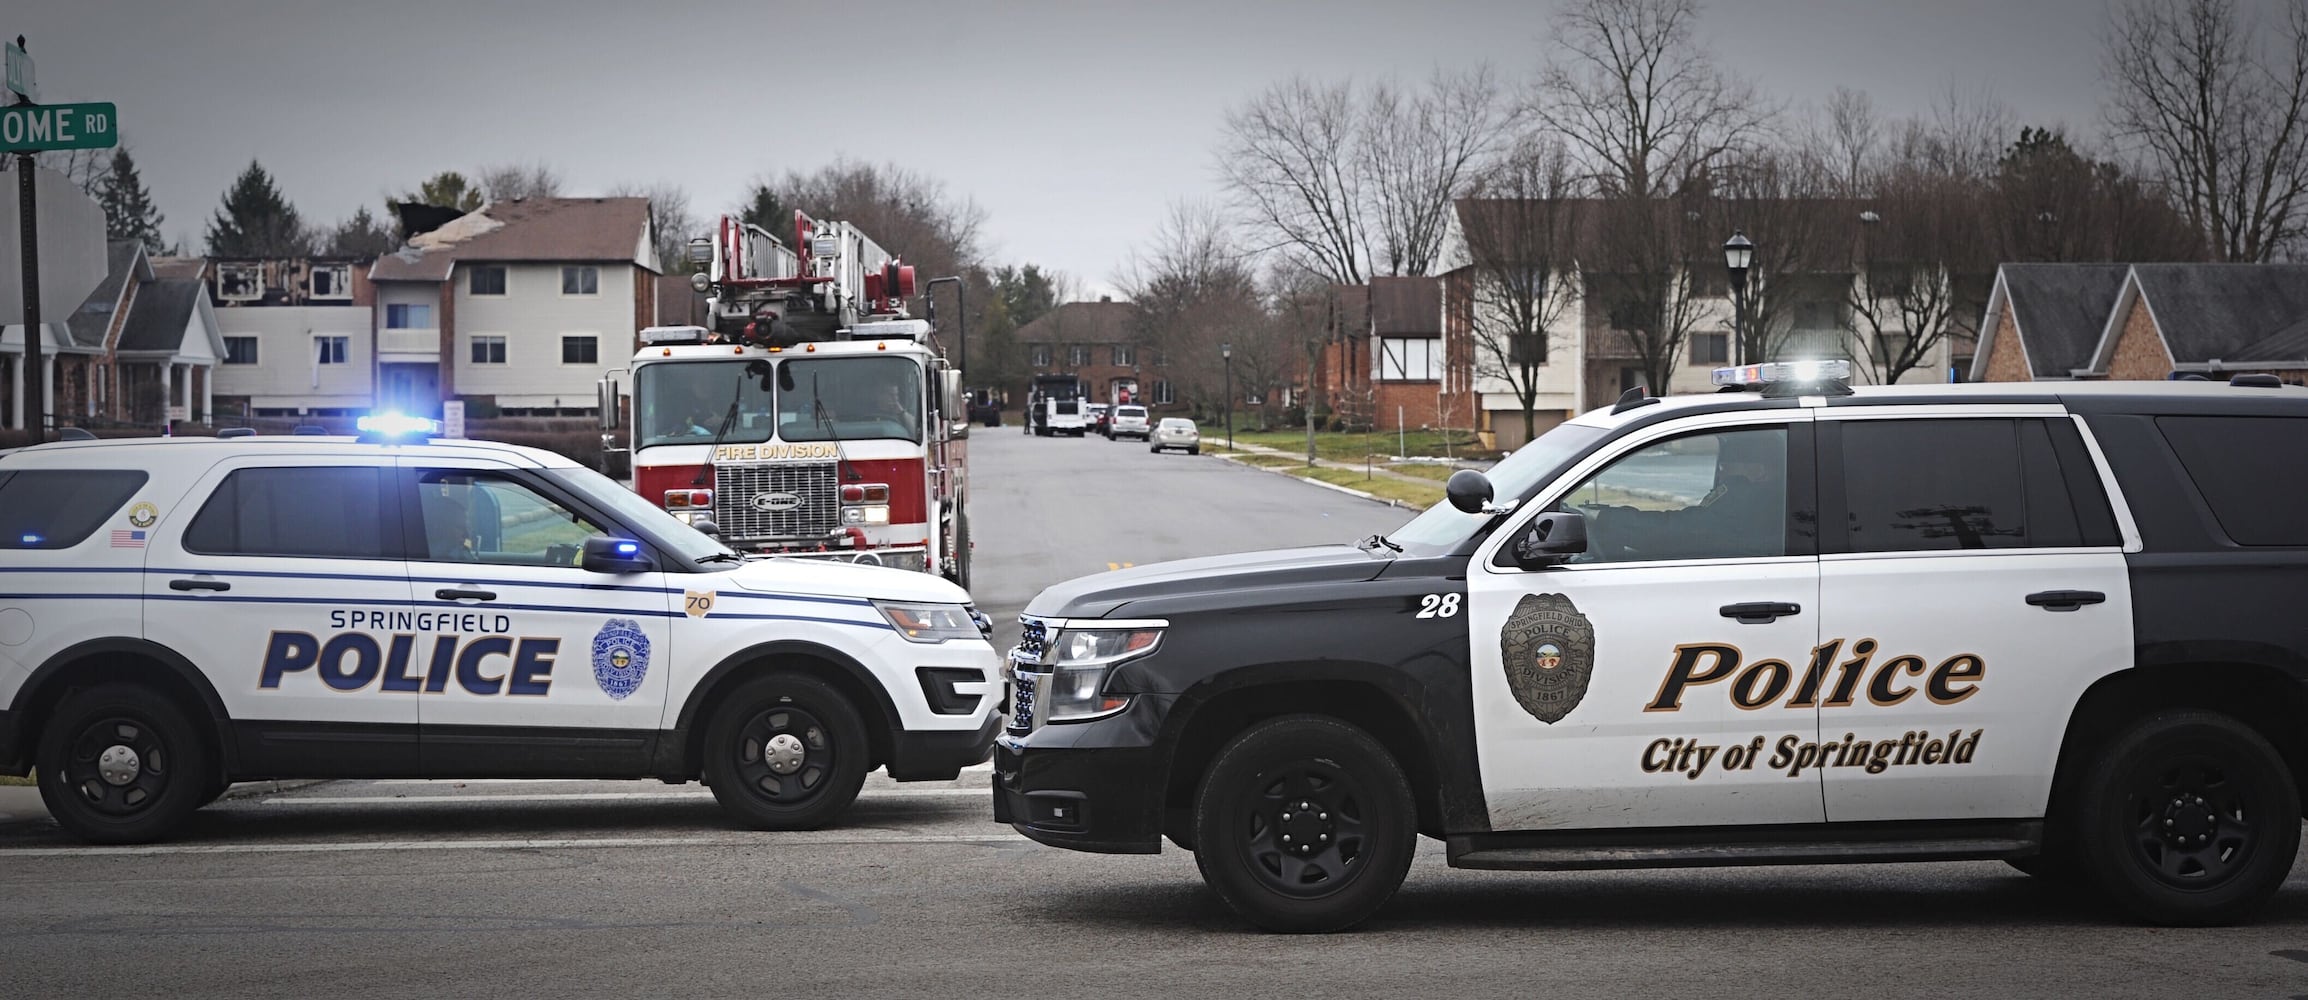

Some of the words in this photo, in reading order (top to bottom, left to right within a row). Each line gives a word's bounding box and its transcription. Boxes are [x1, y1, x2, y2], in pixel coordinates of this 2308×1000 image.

[3, 109, 75, 143] OME
[85, 113, 107, 134] RD
[715, 446, 757, 460] FIRE
[760, 444, 838, 459] DIVISION
[687, 597, 710, 609] 70
[1415, 592, 1461, 619] 28
[330, 609, 511, 634] SPRINGFIELD
[1511, 612, 1563, 629] SPRINGFIELD
[1564, 616, 1583, 627] OHIO
[1524, 624, 1571, 638] POLICE
[256, 630, 562, 698] POLICE
[1523, 666, 1575, 684] DIVISION
[1642, 637, 1986, 713] Police
[1536, 690, 1564, 701] 1867
[1640, 737, 1720, 780] City
[1721, 735, 1766, 771] of
[1767, 728, 1984, 778] Springfield
